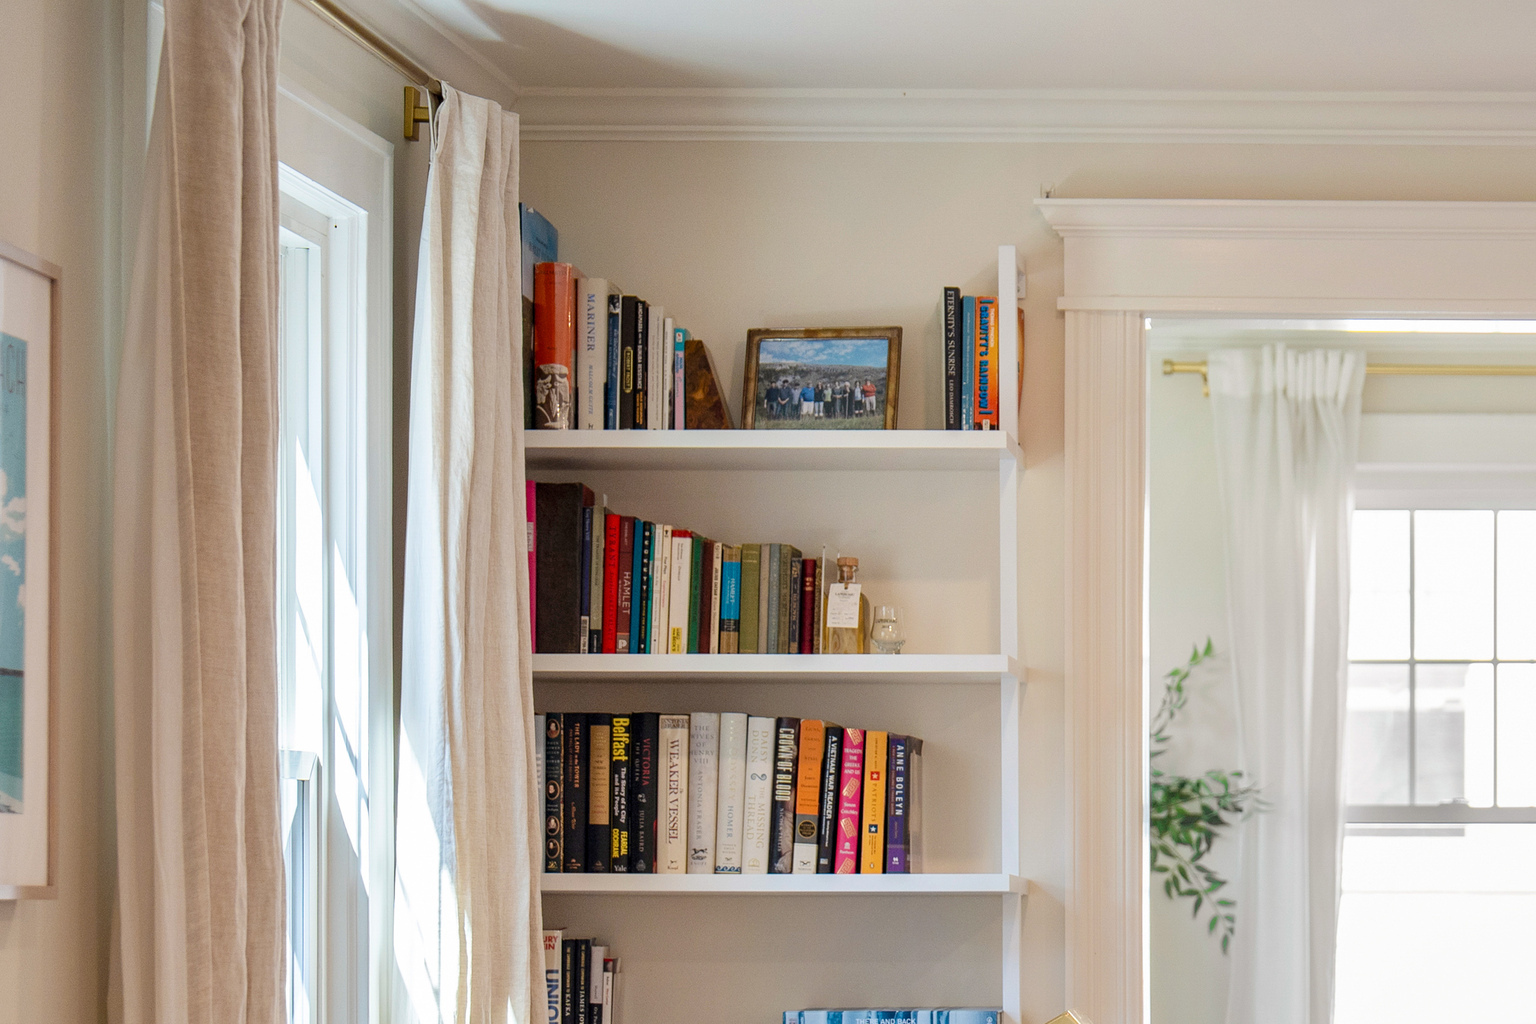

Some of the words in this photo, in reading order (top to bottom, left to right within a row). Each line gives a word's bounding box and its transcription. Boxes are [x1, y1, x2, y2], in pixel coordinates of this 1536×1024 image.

[586, 293, 596, 352] MARINER
[946, 290, 956, 338] ETERNITY'S
[979, 305, 989, 357] GRAVITY'S
[947, 339, 956, 377] SUNRISE
[979, 359, 989, 409] RAINBOW
[608, 525, 617, 569] TYRANT
[621, 571, 631, 615] HAMLET
[612, 717, 630, 763] Belfast
[777, 727, 795, 759] CROWN
[828, 742, 837, 774] VIETNAM
[895, 744, 905, 772] ANNE
[641, 737, 651, 786] VICTORIA
[668, 739, 680, 797] WEAKER
[776, 761, 794, 773] OF
[775, 773, 794, 802] BLOOD
[827, 774, 836, 791] WAR
[894, 776, 904, 816] BOLEYN
[668, 798, 679, 845] VESSEL
[726, 805, 735, 839] HOMER
[825, 791, 834, 820] READER
[612, 828, 620, 859] COCHRANE
[620, 830, 628, 856] FEARGAL
[578, 990, 586, 1013] JAMES
